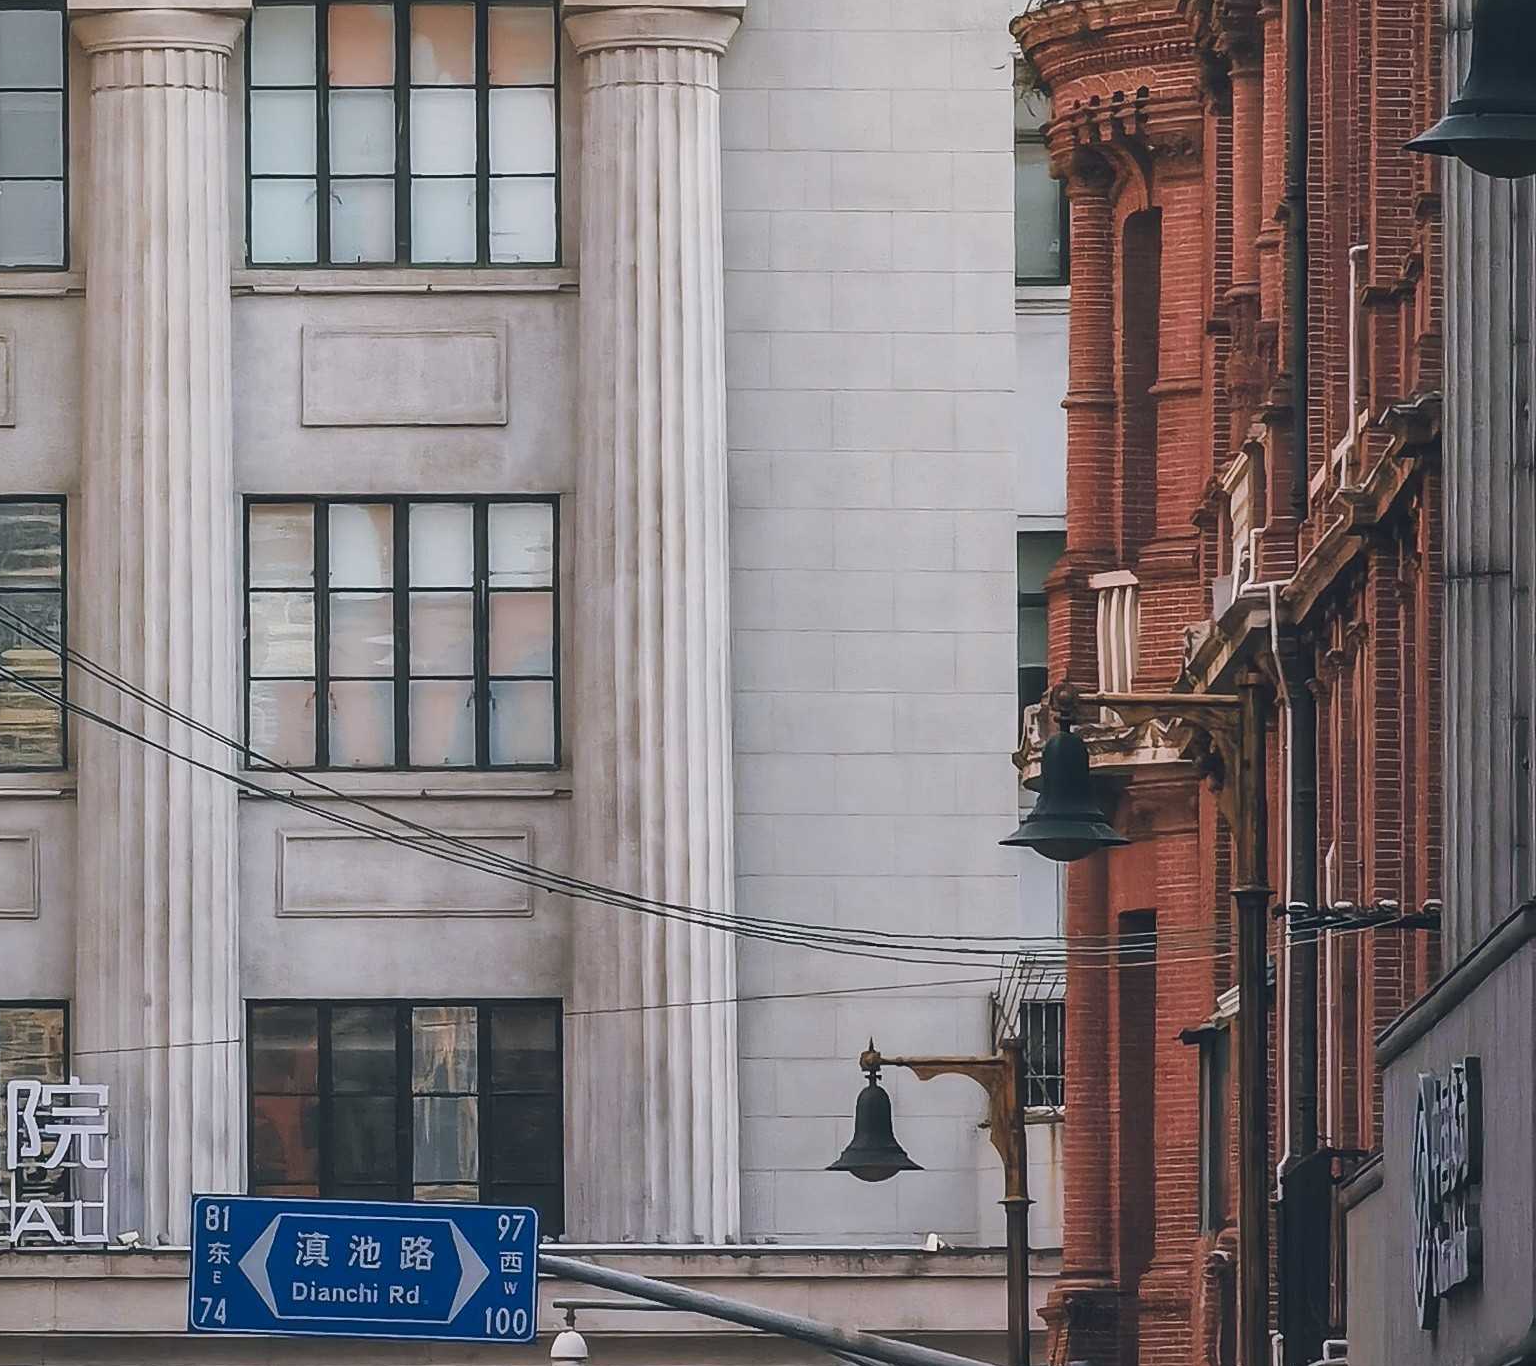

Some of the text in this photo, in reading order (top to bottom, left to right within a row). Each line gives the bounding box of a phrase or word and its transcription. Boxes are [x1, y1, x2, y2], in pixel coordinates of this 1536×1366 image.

[205, 1204, 231, 1233] 81
[497, 1214, 525, 1243] 97
[207, 1241, 232, 1266] 东
[295, 1230, 436, 1272] 滇池路
[500, 1251, 525, 1274] 西
[212, 1270, 222, 1285] E
[503, 1282, 518, 1296] W
[292, 1280, 379, 1304] Dianchi
[199, 1297, 227, 1326] 74
[485, 1307, 528, 1336] 100
